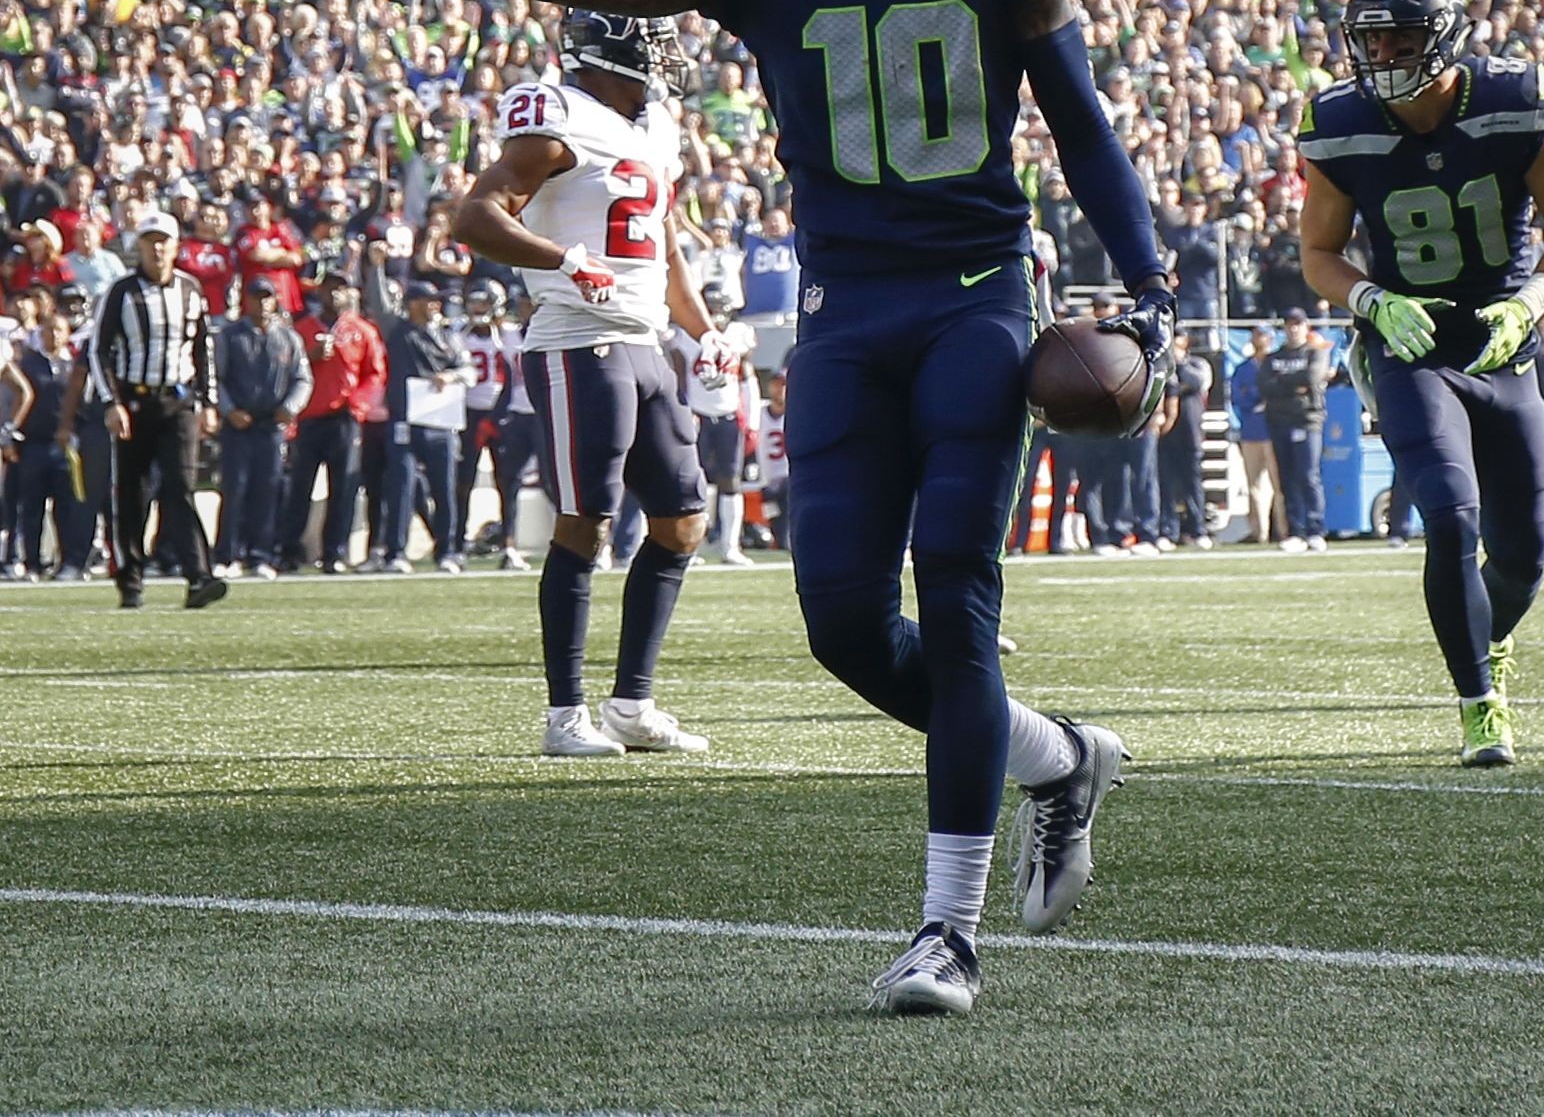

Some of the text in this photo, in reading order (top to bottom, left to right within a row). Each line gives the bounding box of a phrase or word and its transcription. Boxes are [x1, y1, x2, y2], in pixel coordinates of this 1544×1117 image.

[507, 93, 547, 131] 21
[605, 158, 678, 260] 2
[1383, 173, 1511, 285] 81
